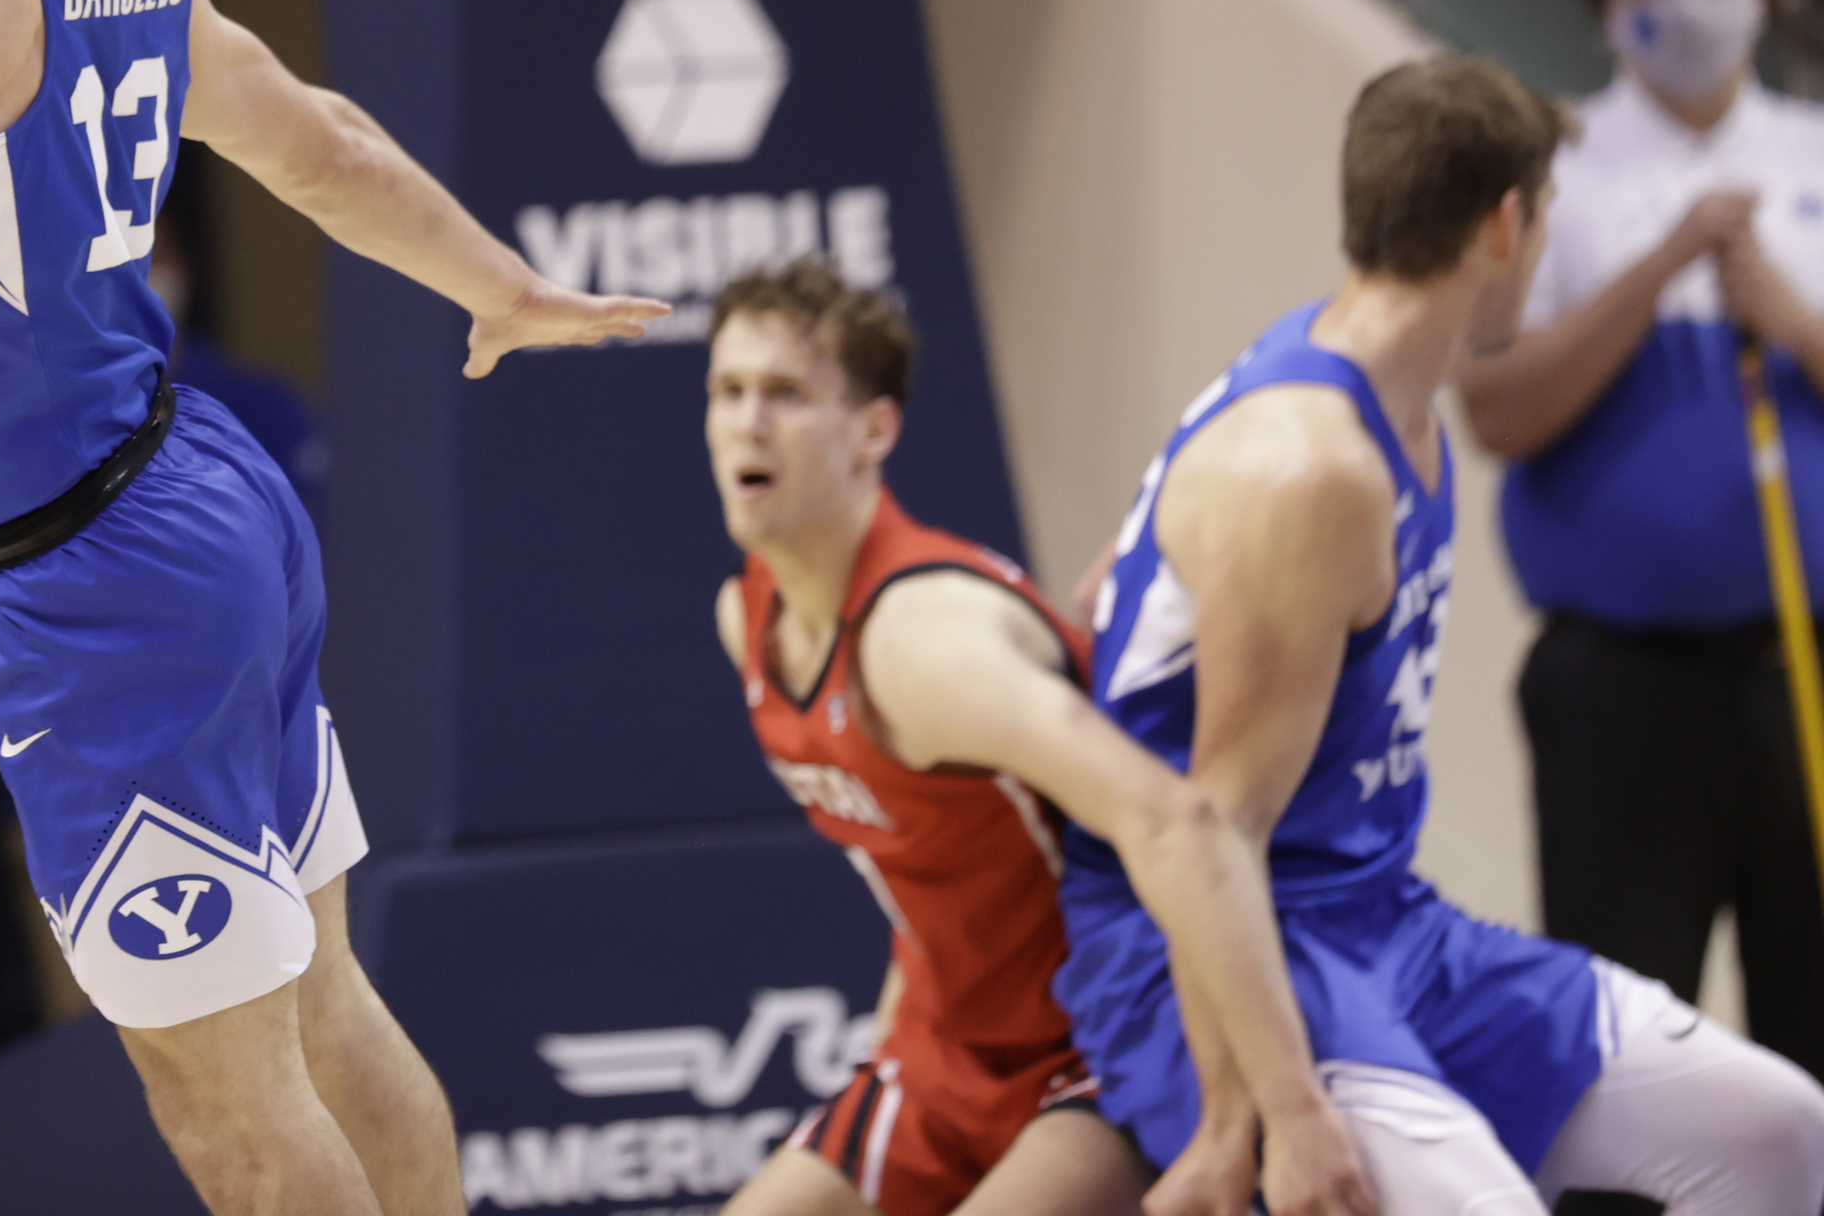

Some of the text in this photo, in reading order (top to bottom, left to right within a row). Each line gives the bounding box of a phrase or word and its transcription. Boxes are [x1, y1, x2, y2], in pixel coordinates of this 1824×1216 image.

[69, 55, 171, 273] 13
[514, 185, 896, 298] VISIBLE
[116, 879, 213, 957] Y
